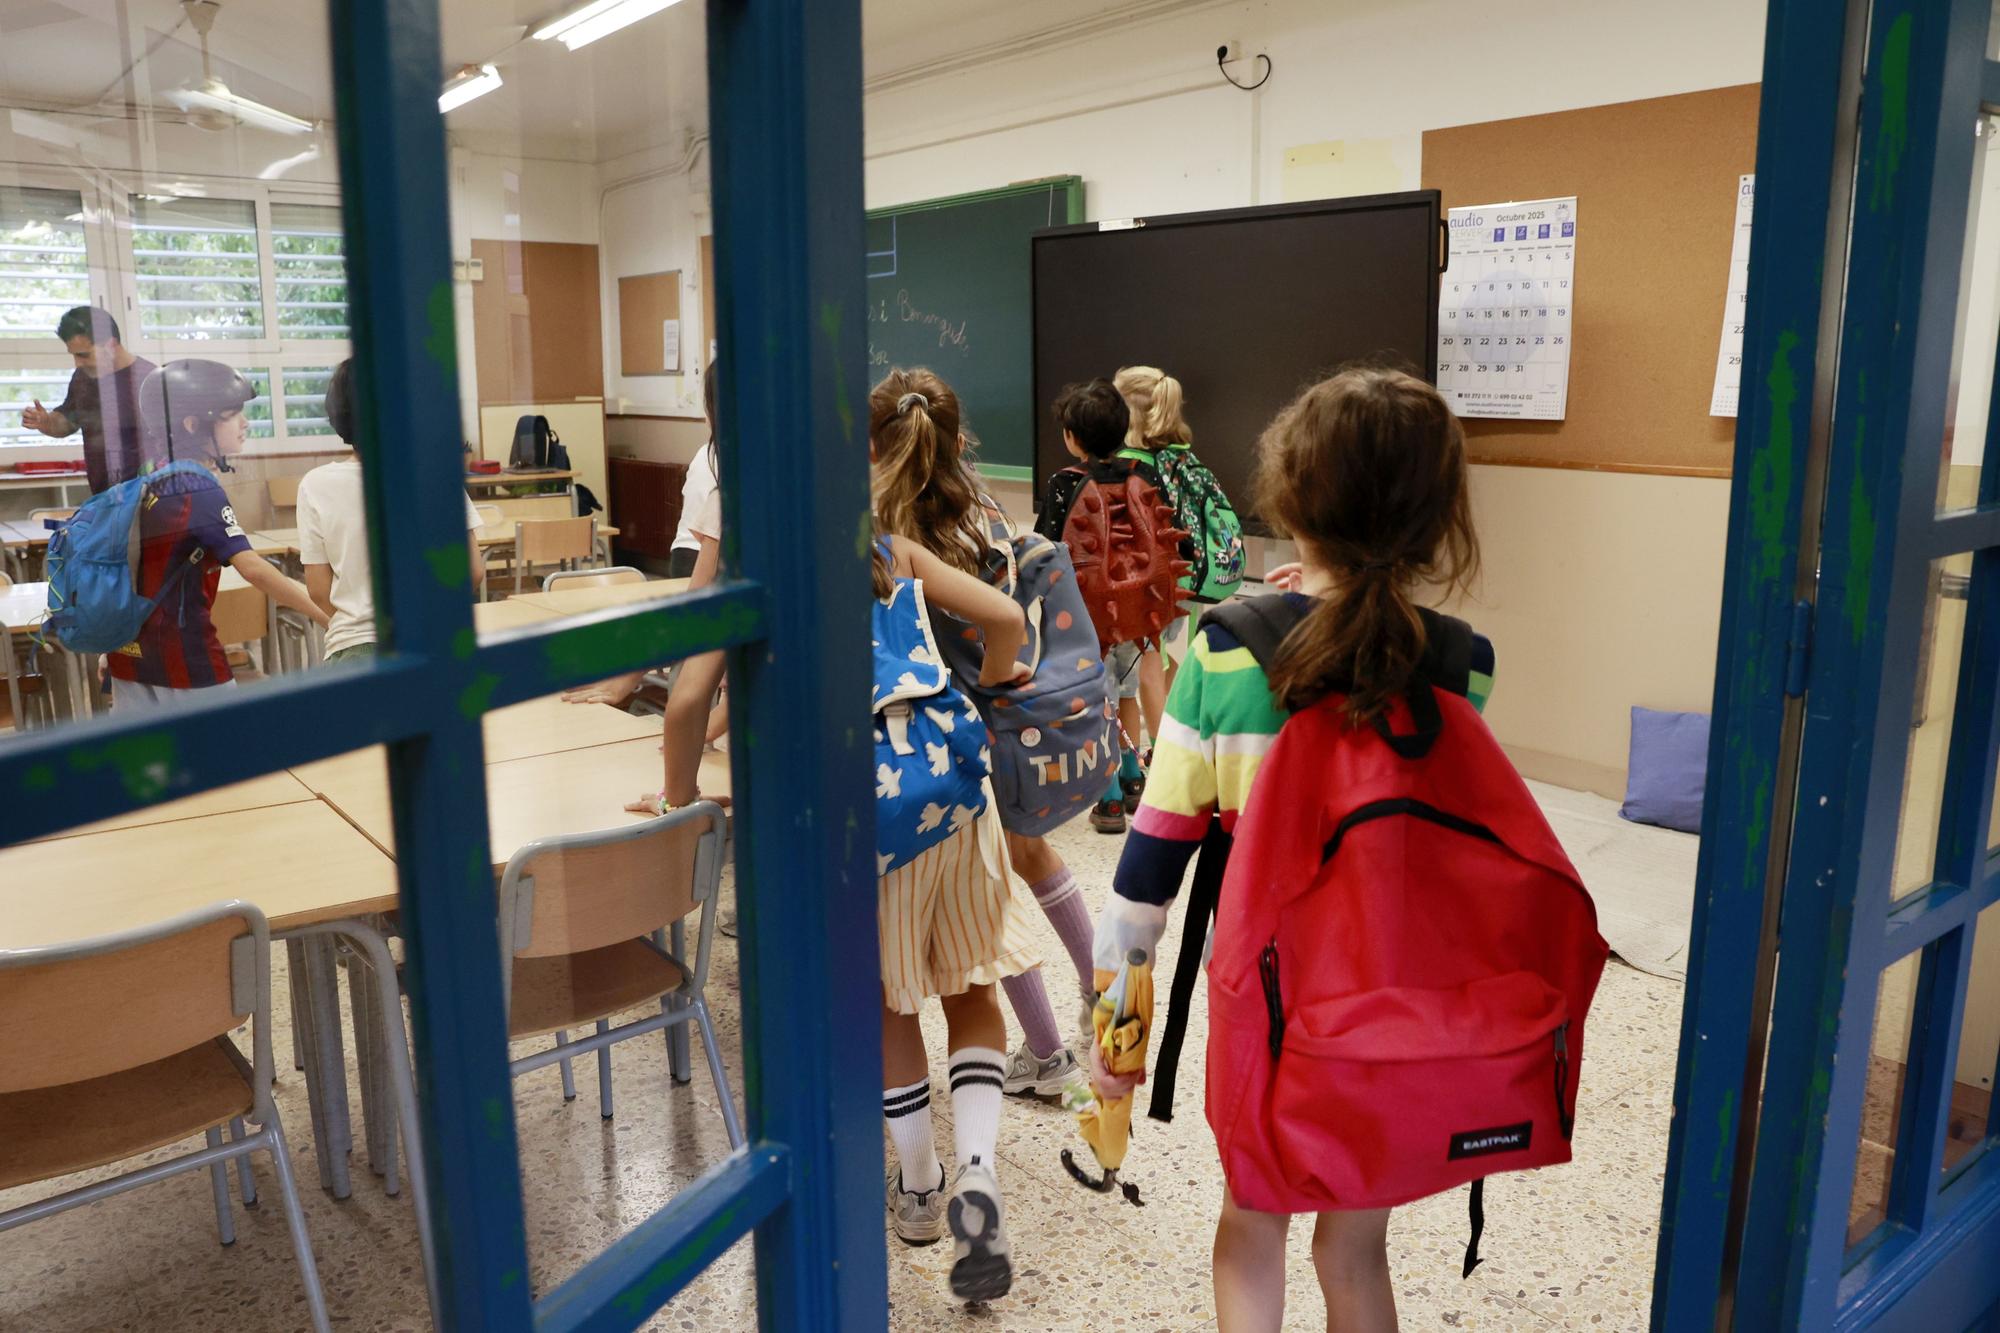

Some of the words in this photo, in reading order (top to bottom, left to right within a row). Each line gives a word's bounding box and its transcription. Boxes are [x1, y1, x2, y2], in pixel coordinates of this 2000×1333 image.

[1450, 214, 1483, 229] audio
[1497, 213, 1525, 223] Octubre
[1528, 211, 1545, 220] 2025
[1546, 253, 1551, 261] 4
[1565, 252, 1570, 260] 5
[1472, 284, 1477, 292] 7
[1507, 283, 1512, 291] 9
[1522, 282, 1530, 290] 10
[1543, 281, 1549, 289] 11
[1560, 280, 1568, 288] 12
[1448, 311, 1456, 319] 13
[1484, 310, 1492, 318] 15
[1502, 310, 1510, 318] 16
[1520, 309, 1528, 317] 17
[1538, 309, 1547, 317] 18
[1442, 337, 1453, 345] 20
[1463, 337, 1471, 345] 21
[1480, 337, 1489, 345] 22
[1498, 337, 1507, 345] 23
[1516, 337, 1525, 345] 24
[1535, 337, 1544, 345] 25
[1553, 337, 1563, 345] 26
[1729, 357, 1741, 365] 29
[1459, 364, 1468, 372] 28
[1477, 364, 1487, 372] 29
[1495, 364, 1505, 372] 30
[1515, 364, 1523, 372] 31
[1029, 723, 1111, 786] TINY
[1463, 1134, 1519, 1150] EASTPAK
